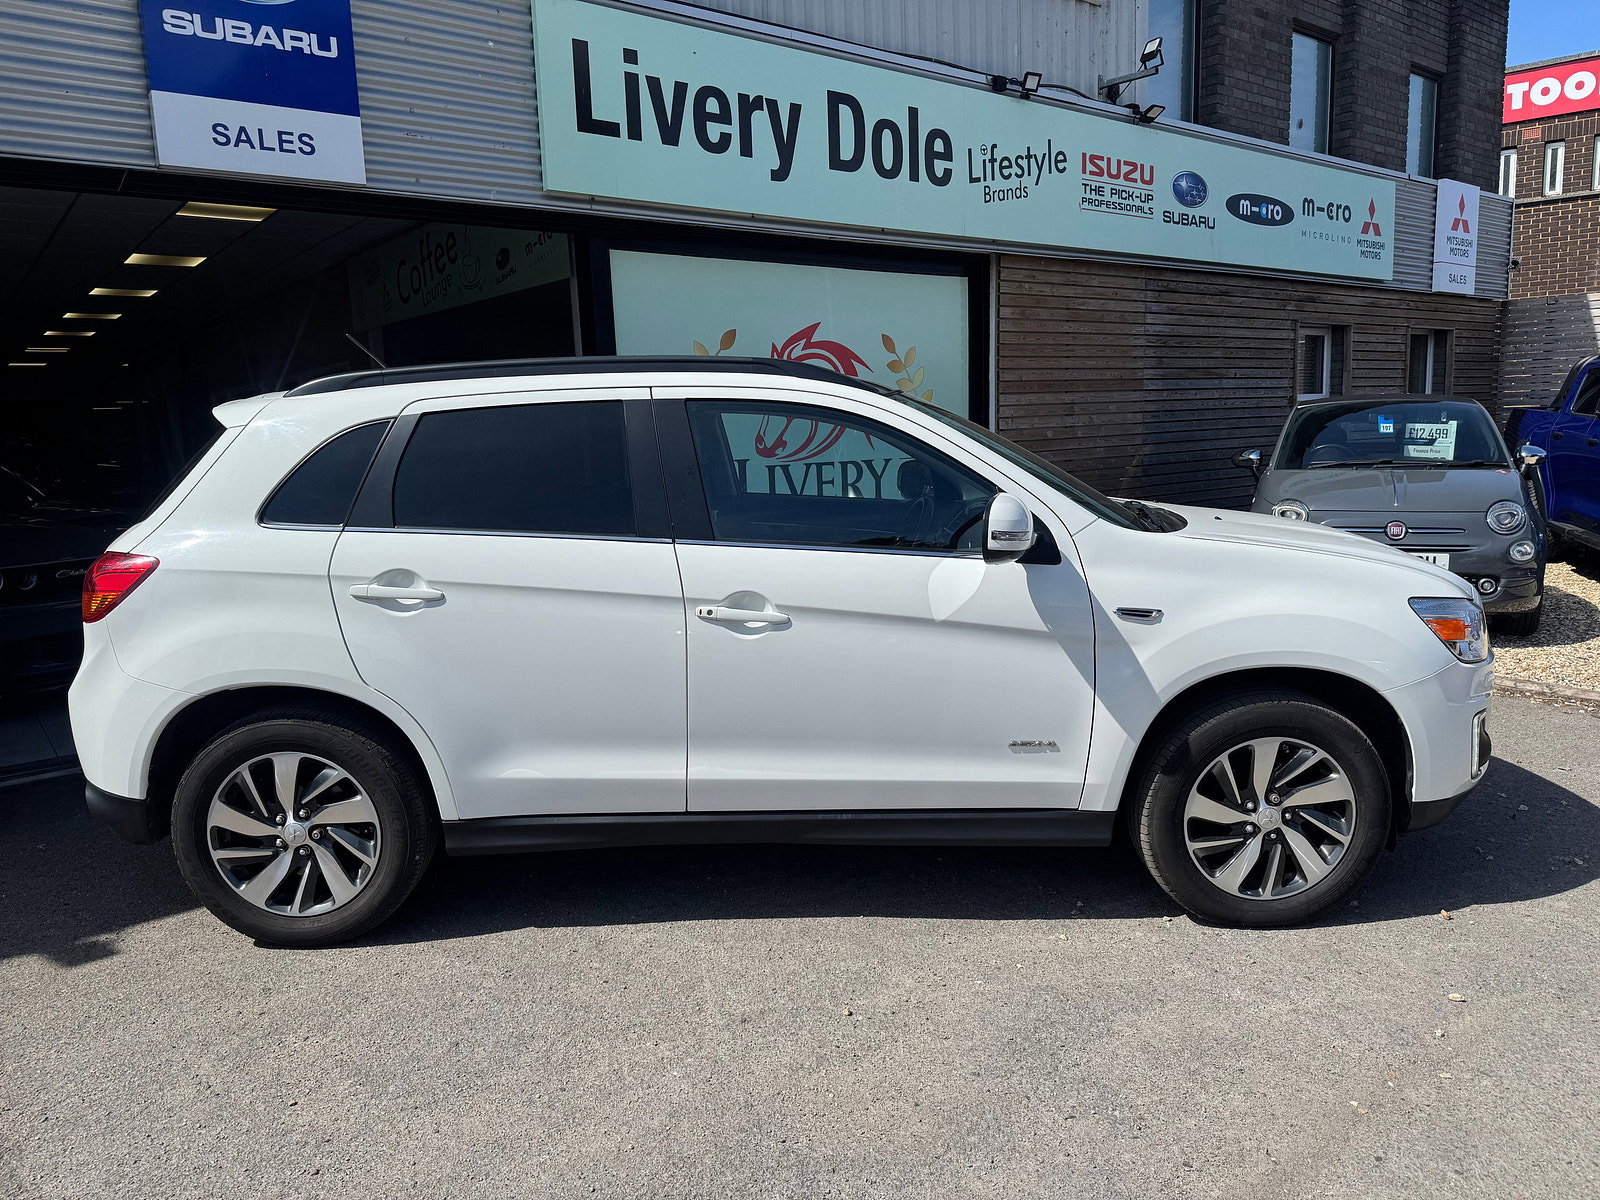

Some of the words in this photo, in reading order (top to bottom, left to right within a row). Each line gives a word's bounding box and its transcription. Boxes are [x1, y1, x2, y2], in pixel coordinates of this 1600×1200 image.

[162, 8, 339, 59] SUBARU
[1507, 70, 1600, 111] TOO
[571, 38, 802, 183] Livery
[826, 90, 954, 188] Dole
[212, 122, 316, 156] SALES
[967, 138, 1068, 187] Lifestyle
[1081, 151, 1154, 186] ISUZU
[983, 184, 1029, 204] Brands
[1081, 182, 1105, 197] THE
[1110, 187, 1154, 204] PICK-UP
[1081, 197, 1154, 216] PROFESSIONALS
[1162, 210, 1216, 230] SUBARU
[1301, 230, 1352, 244] MICROLINO
[1356, 238, 1386, 250] MITSUBISHI
[1446, 235, 1473, 248] MITSUBISHI
[1359, 249, 1382, 260] MOTORS
[1449, 246, 1469, 258] MOTORS
[396, 231, 458, 304] Coffee
[1448, 273, 1467, 285] SALES
[421, 272, 452, 308] Lounge
[1390, 526, 1403, 535] FIAT
